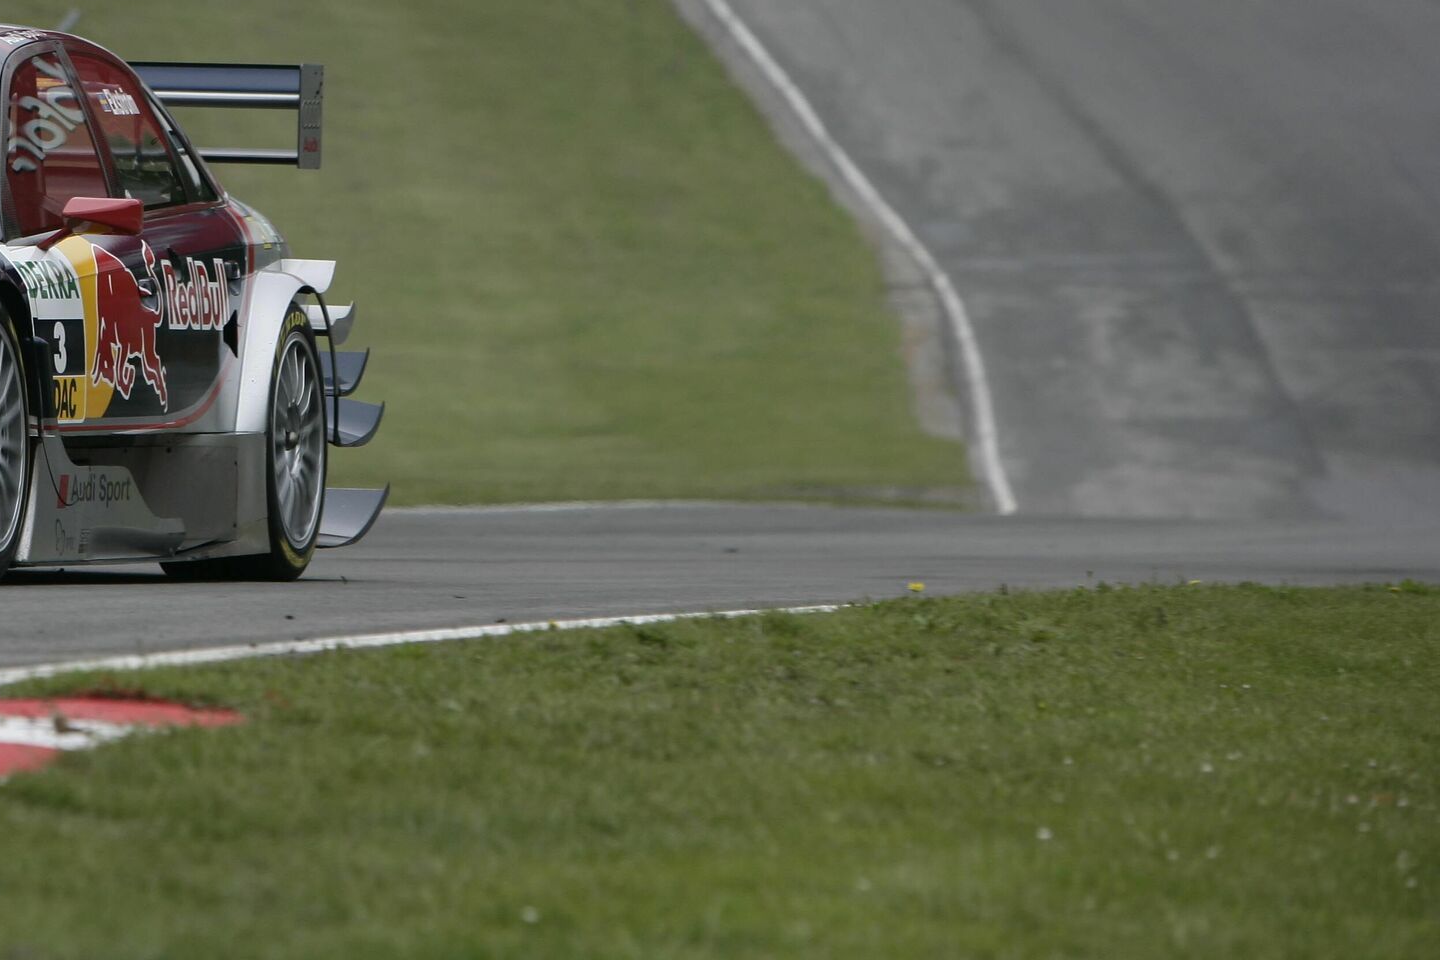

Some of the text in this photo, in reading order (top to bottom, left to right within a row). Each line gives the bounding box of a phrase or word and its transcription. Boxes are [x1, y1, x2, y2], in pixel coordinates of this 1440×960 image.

[13, 260, 80, 300] DEKRA
[161, 257, 230, 330] Red Bull
[53, 321, 67, 374] 3
[53, 378, 77, 418] DAC
[71, 473, 131, 509] Audi Sport
